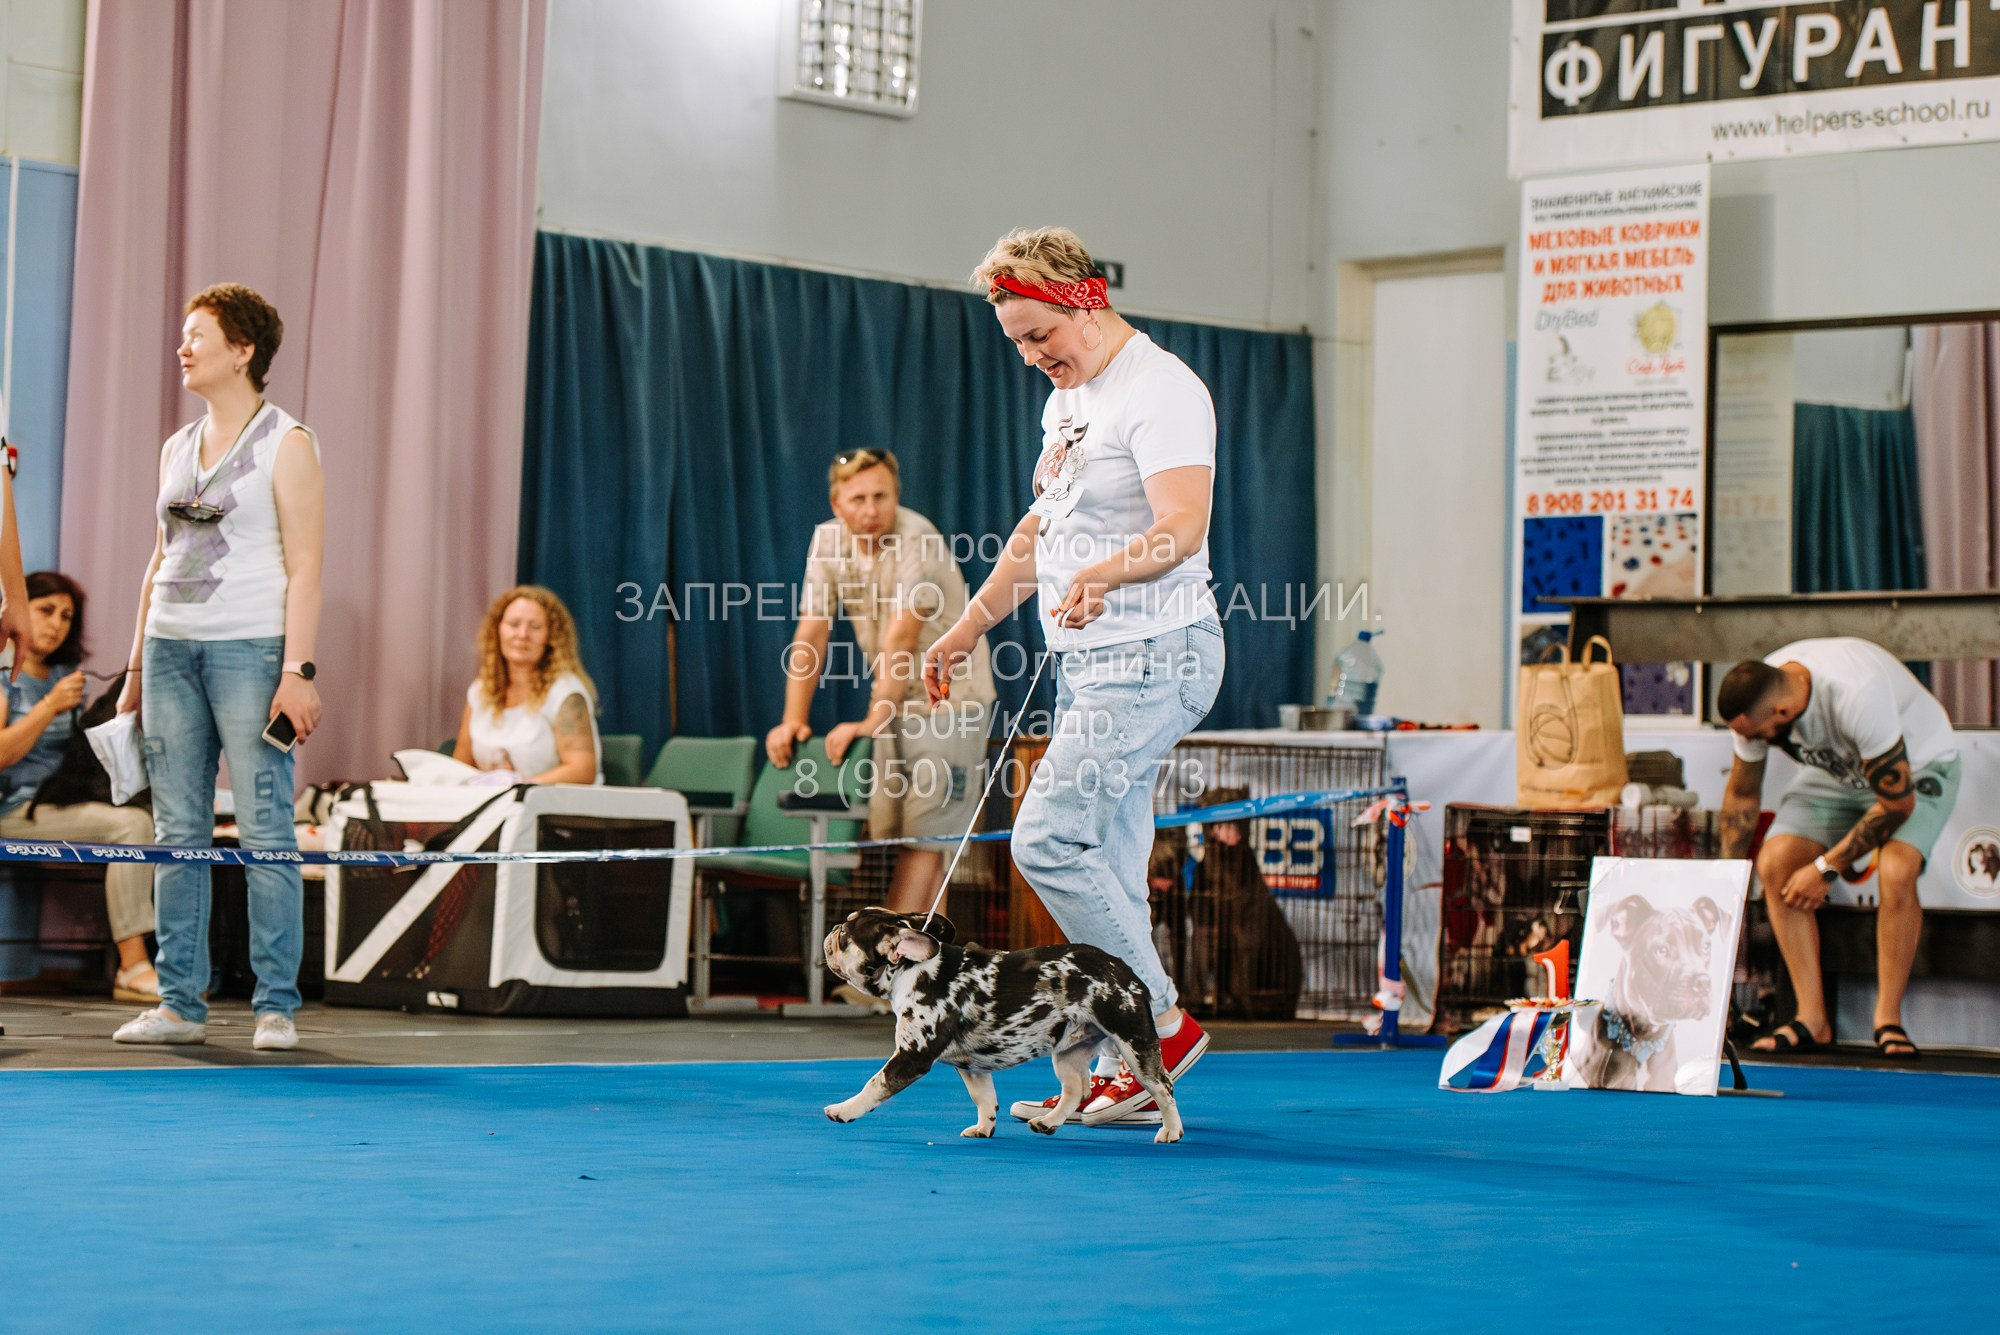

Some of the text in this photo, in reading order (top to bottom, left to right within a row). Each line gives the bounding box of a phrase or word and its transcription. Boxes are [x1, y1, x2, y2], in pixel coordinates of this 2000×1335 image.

[1544, 0, 2000, 107] ФИГУРАН
[1711, 97, 1991, 139] www.helpers-school.ru
[1529, 220, 1700, 251] МЕХОВЫЕ КОВРИКИ
[1534, 247, 1695, 276] И МЯГКАЯ МЕБЕЛЬ
[1542, 274, 1684, 306] ДЛЯ ЖИВОТНЫХ
[1045, 488, 1070, 501] 30
[1526, 492, 1540, 514] 8
[1543, 492, 1583, 513] 908
[1589, 490, 1627, 512] 201
[1635, 490, 1658, 510] 31
[1667, 488, 1694, 509] 74
